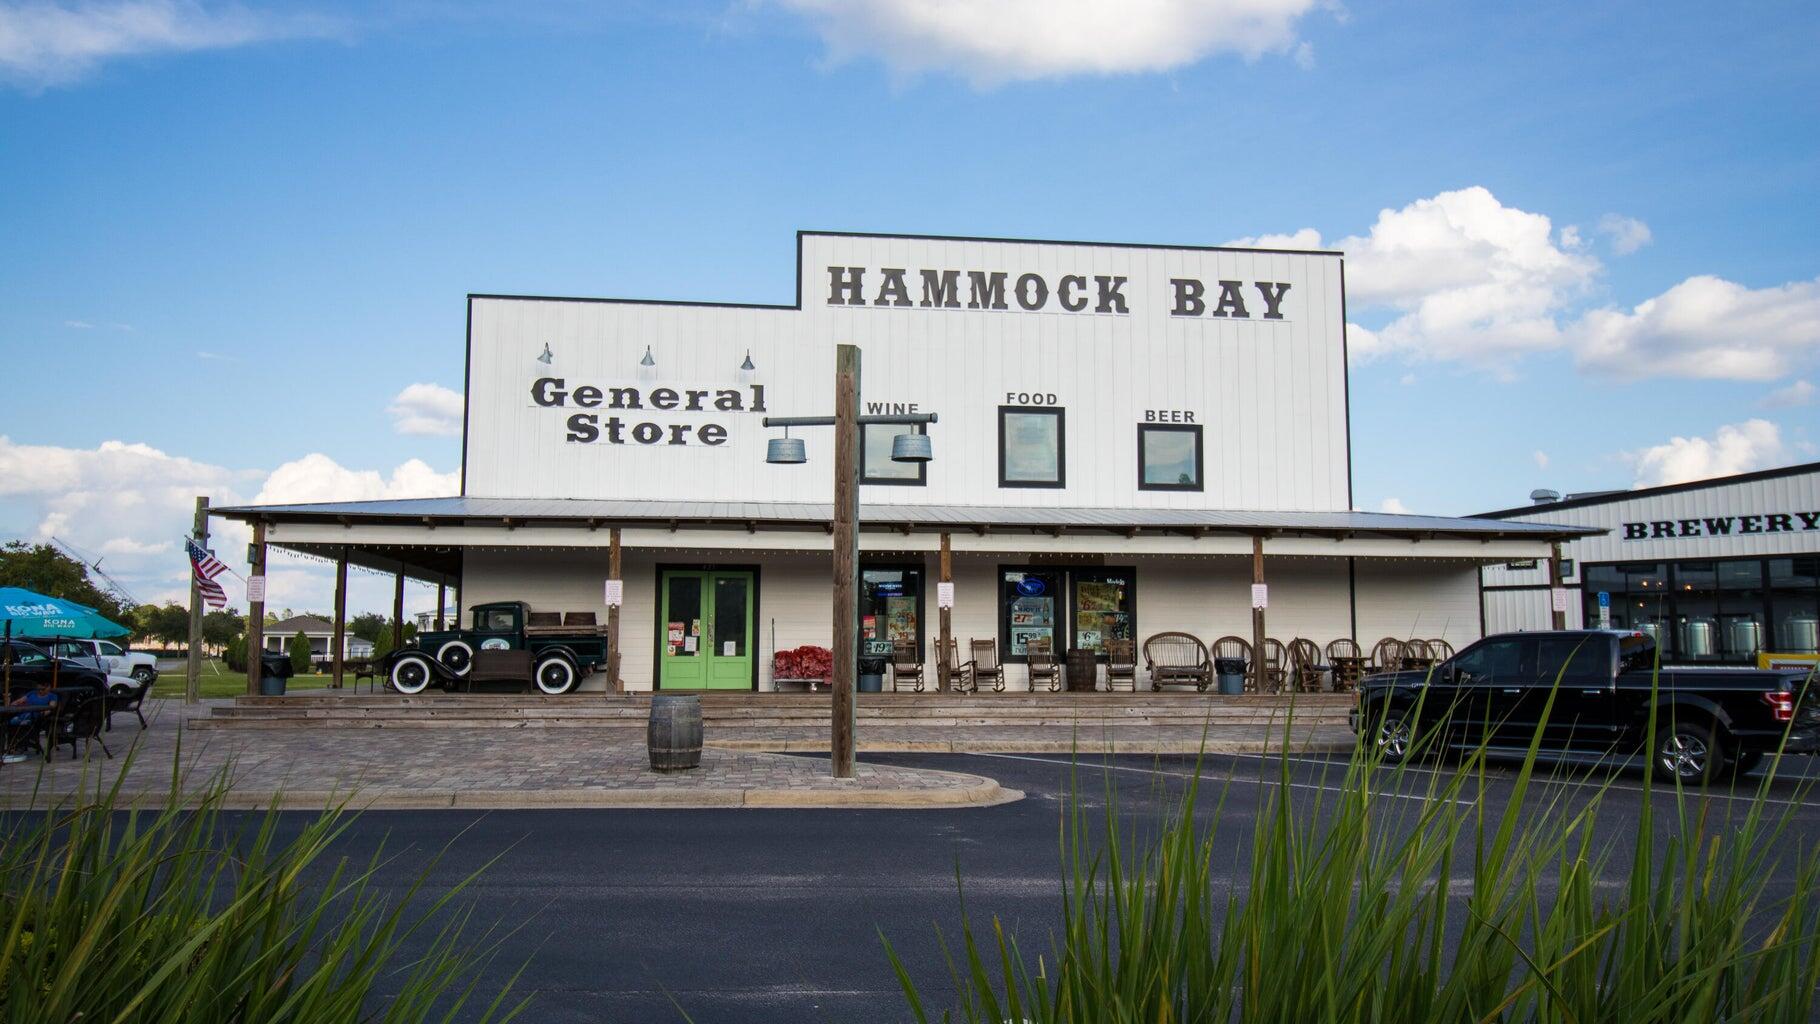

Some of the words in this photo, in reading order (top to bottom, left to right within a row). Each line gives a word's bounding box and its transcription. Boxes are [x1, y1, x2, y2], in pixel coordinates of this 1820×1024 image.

[827, 266, 1130, 314] HAMMOCK
[1169, 278, 1292, 320] BAY
[531, 377, 767, 412] General
[867, 402, 919, 415] WINE
[1006, 392, 1058, 406] FOOD
[566, 413, 728, 446] Store
[1145, 409, 1196, 424] BEER
[1623, 512, 1820, 540] BREWERY
